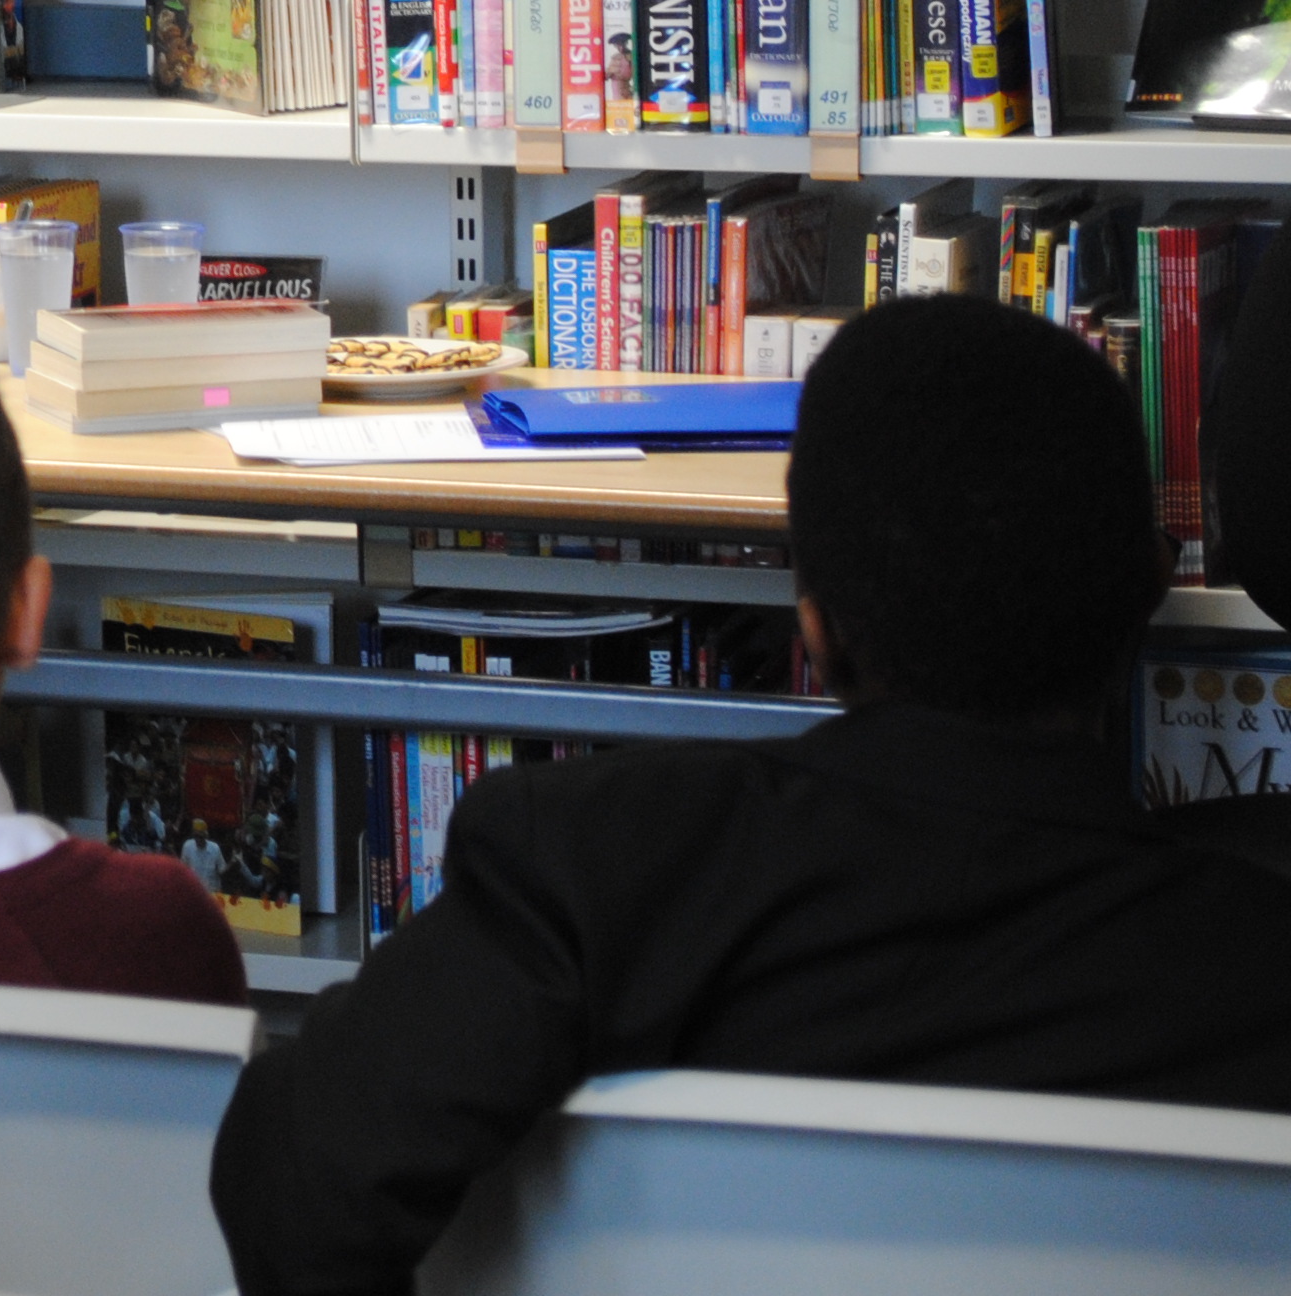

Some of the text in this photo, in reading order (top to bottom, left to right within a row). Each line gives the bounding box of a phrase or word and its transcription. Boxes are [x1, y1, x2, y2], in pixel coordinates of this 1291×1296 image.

[372, 6, 386, 96] ITALIAN
[523, 95, 553, 110] 460
[820, 91, 849, 105] 491
[750, 112, 802, 123] OXFORD
[821, 111, 848, 125] .85
[600, 227, 614, 313] Children's
[881, 255, 894, 281] THE
[898, 218, 913, 293] SCIENTISTS
[1160, 700, 1227, 731] Look
[1237, 707, 1260, 733] &
[392, 751, 405, 880] Mathematics Study Dictionary
